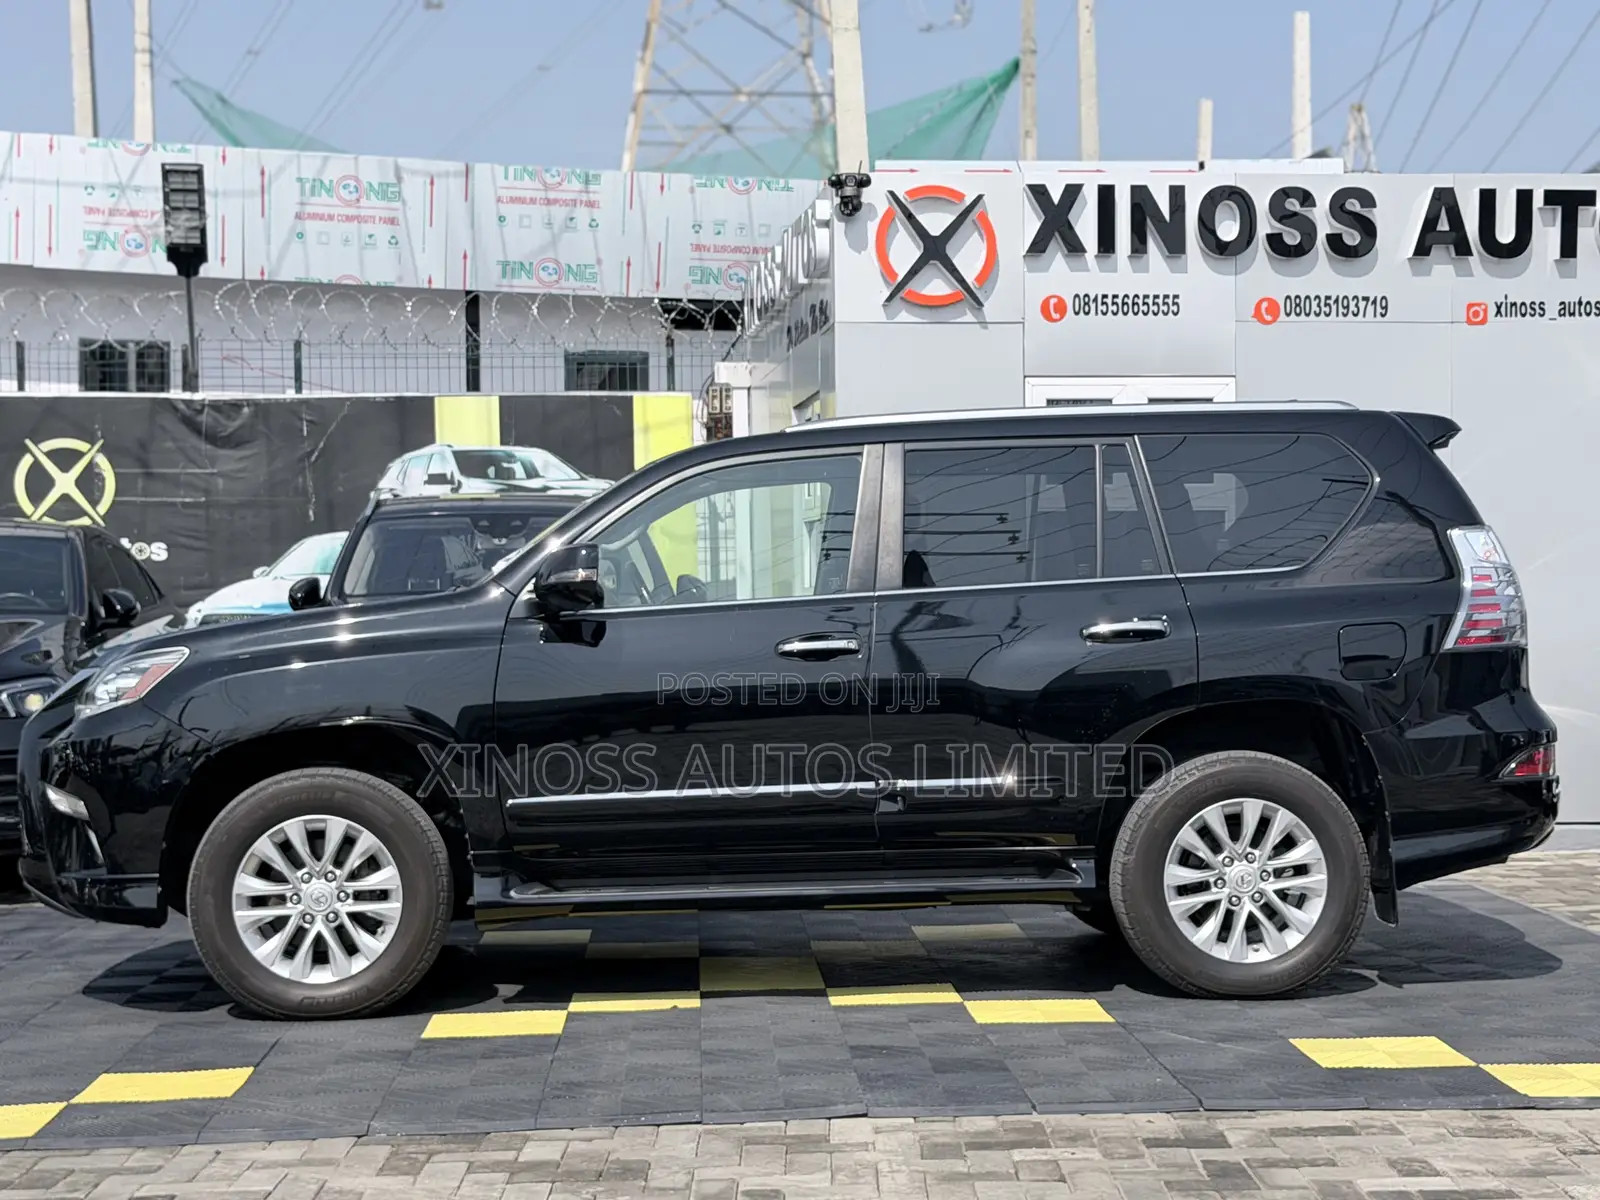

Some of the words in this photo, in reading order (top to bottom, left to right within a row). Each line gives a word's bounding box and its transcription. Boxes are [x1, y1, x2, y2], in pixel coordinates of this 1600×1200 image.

[496, 195, 537, 206] ALUMINIUM
[538, 197, 578, 208] COMPOSITE
[579, 199, 602, 209] PANEL
[295, 211, 336, 222] ALUMINIUM
[337, 213, 377, 225] COMPOSITE
[378, 216, 400, 226] PANEL
[1024, 182, 1378, 260] XINOSS
[1409, 186, 1600, 260] AUT
[1072, 293, 1181, 316] 08155665555
[1283, 294, 1389, 318] 08035193719
